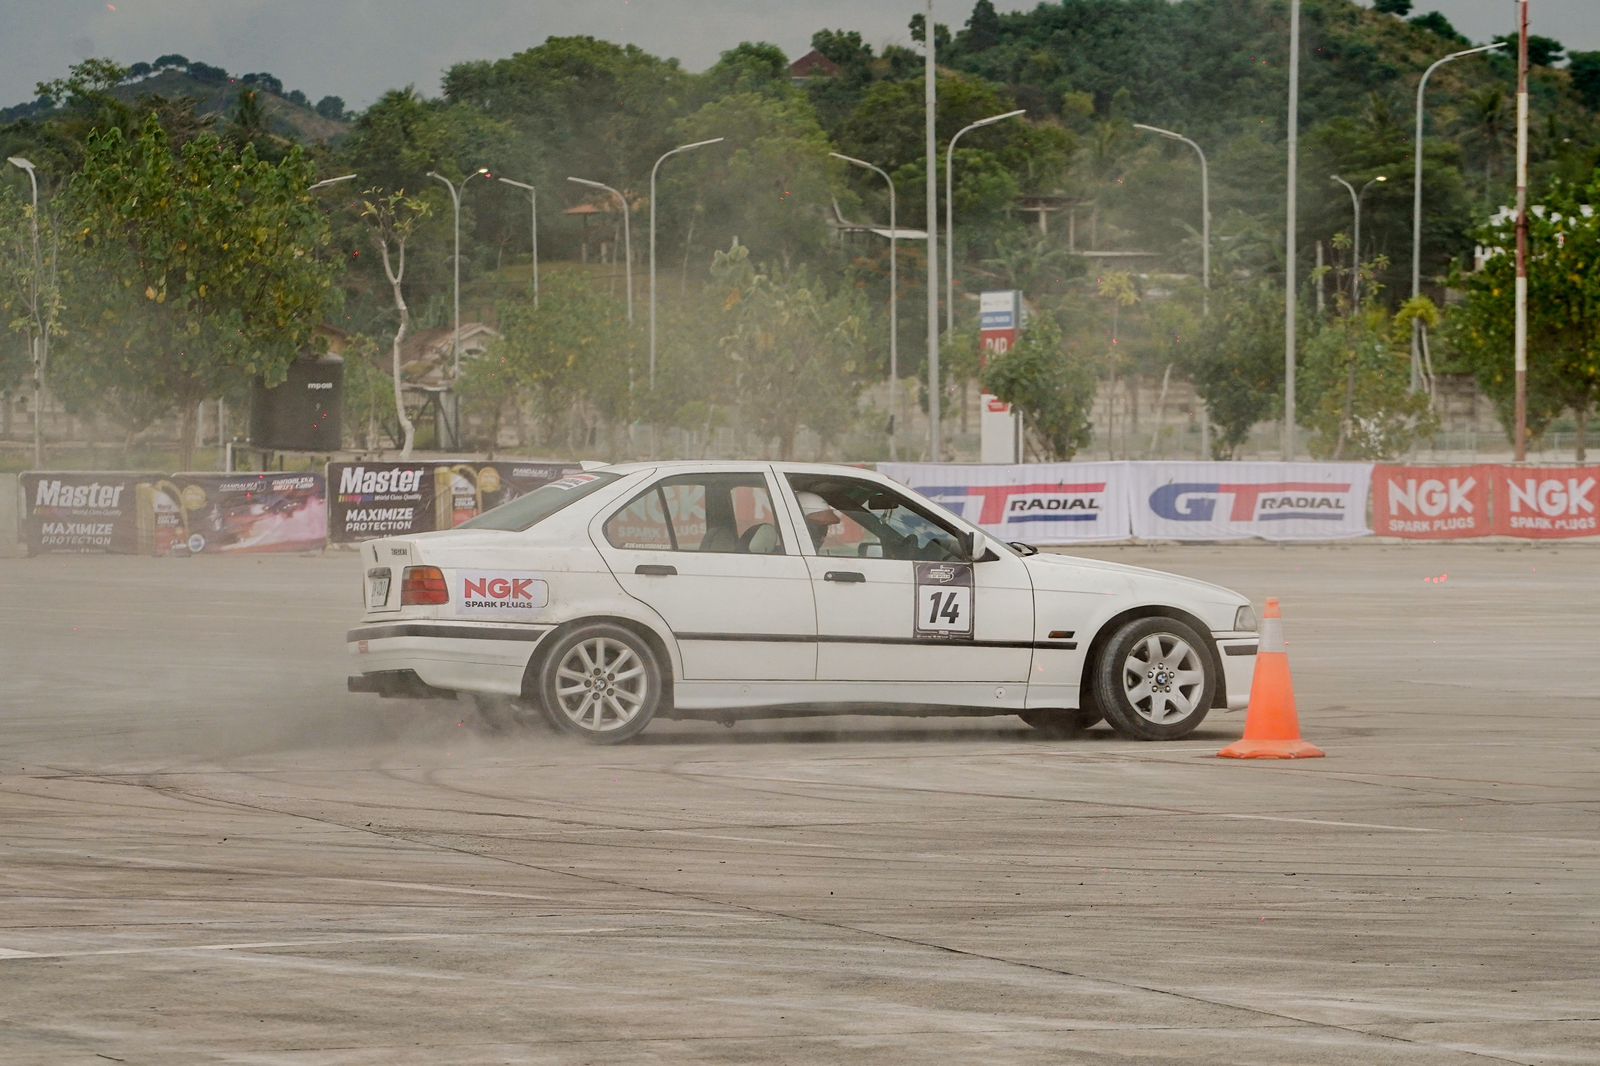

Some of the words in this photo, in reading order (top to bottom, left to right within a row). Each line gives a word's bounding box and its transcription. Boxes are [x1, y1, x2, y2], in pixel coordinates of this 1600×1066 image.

[338, 467, 424, 494] Master
[35, 479, 125, 507] Master
[1388, 476, 1477, 517] NGK
[1507, 475, 1597, 517] NGK
[1010, 498, 1101, 512] RADIAL
[1260, 496, 1345, 510] RADIAL
[345, 508, 414, 522] MAXIMIZE
[42, 522, 114, 535] MAXIMIZE
[345, 520, 412, 532] PROTECTION
[1389, 517, 1430, 532] SPARK
[1433, 516, 1476, 531] PLUGS
[1510, 516, 1552, 530] SPARK
[1555, 516, 1597, 530] PLUGS
[41, 535, 112, 545] PROTECTION
[464, 578, 534, 600] NGK
[465, 600, 497, 608] SPARK
[500, 601, 533, 609] PLUGS
[929, 591, 960, 624] 14
